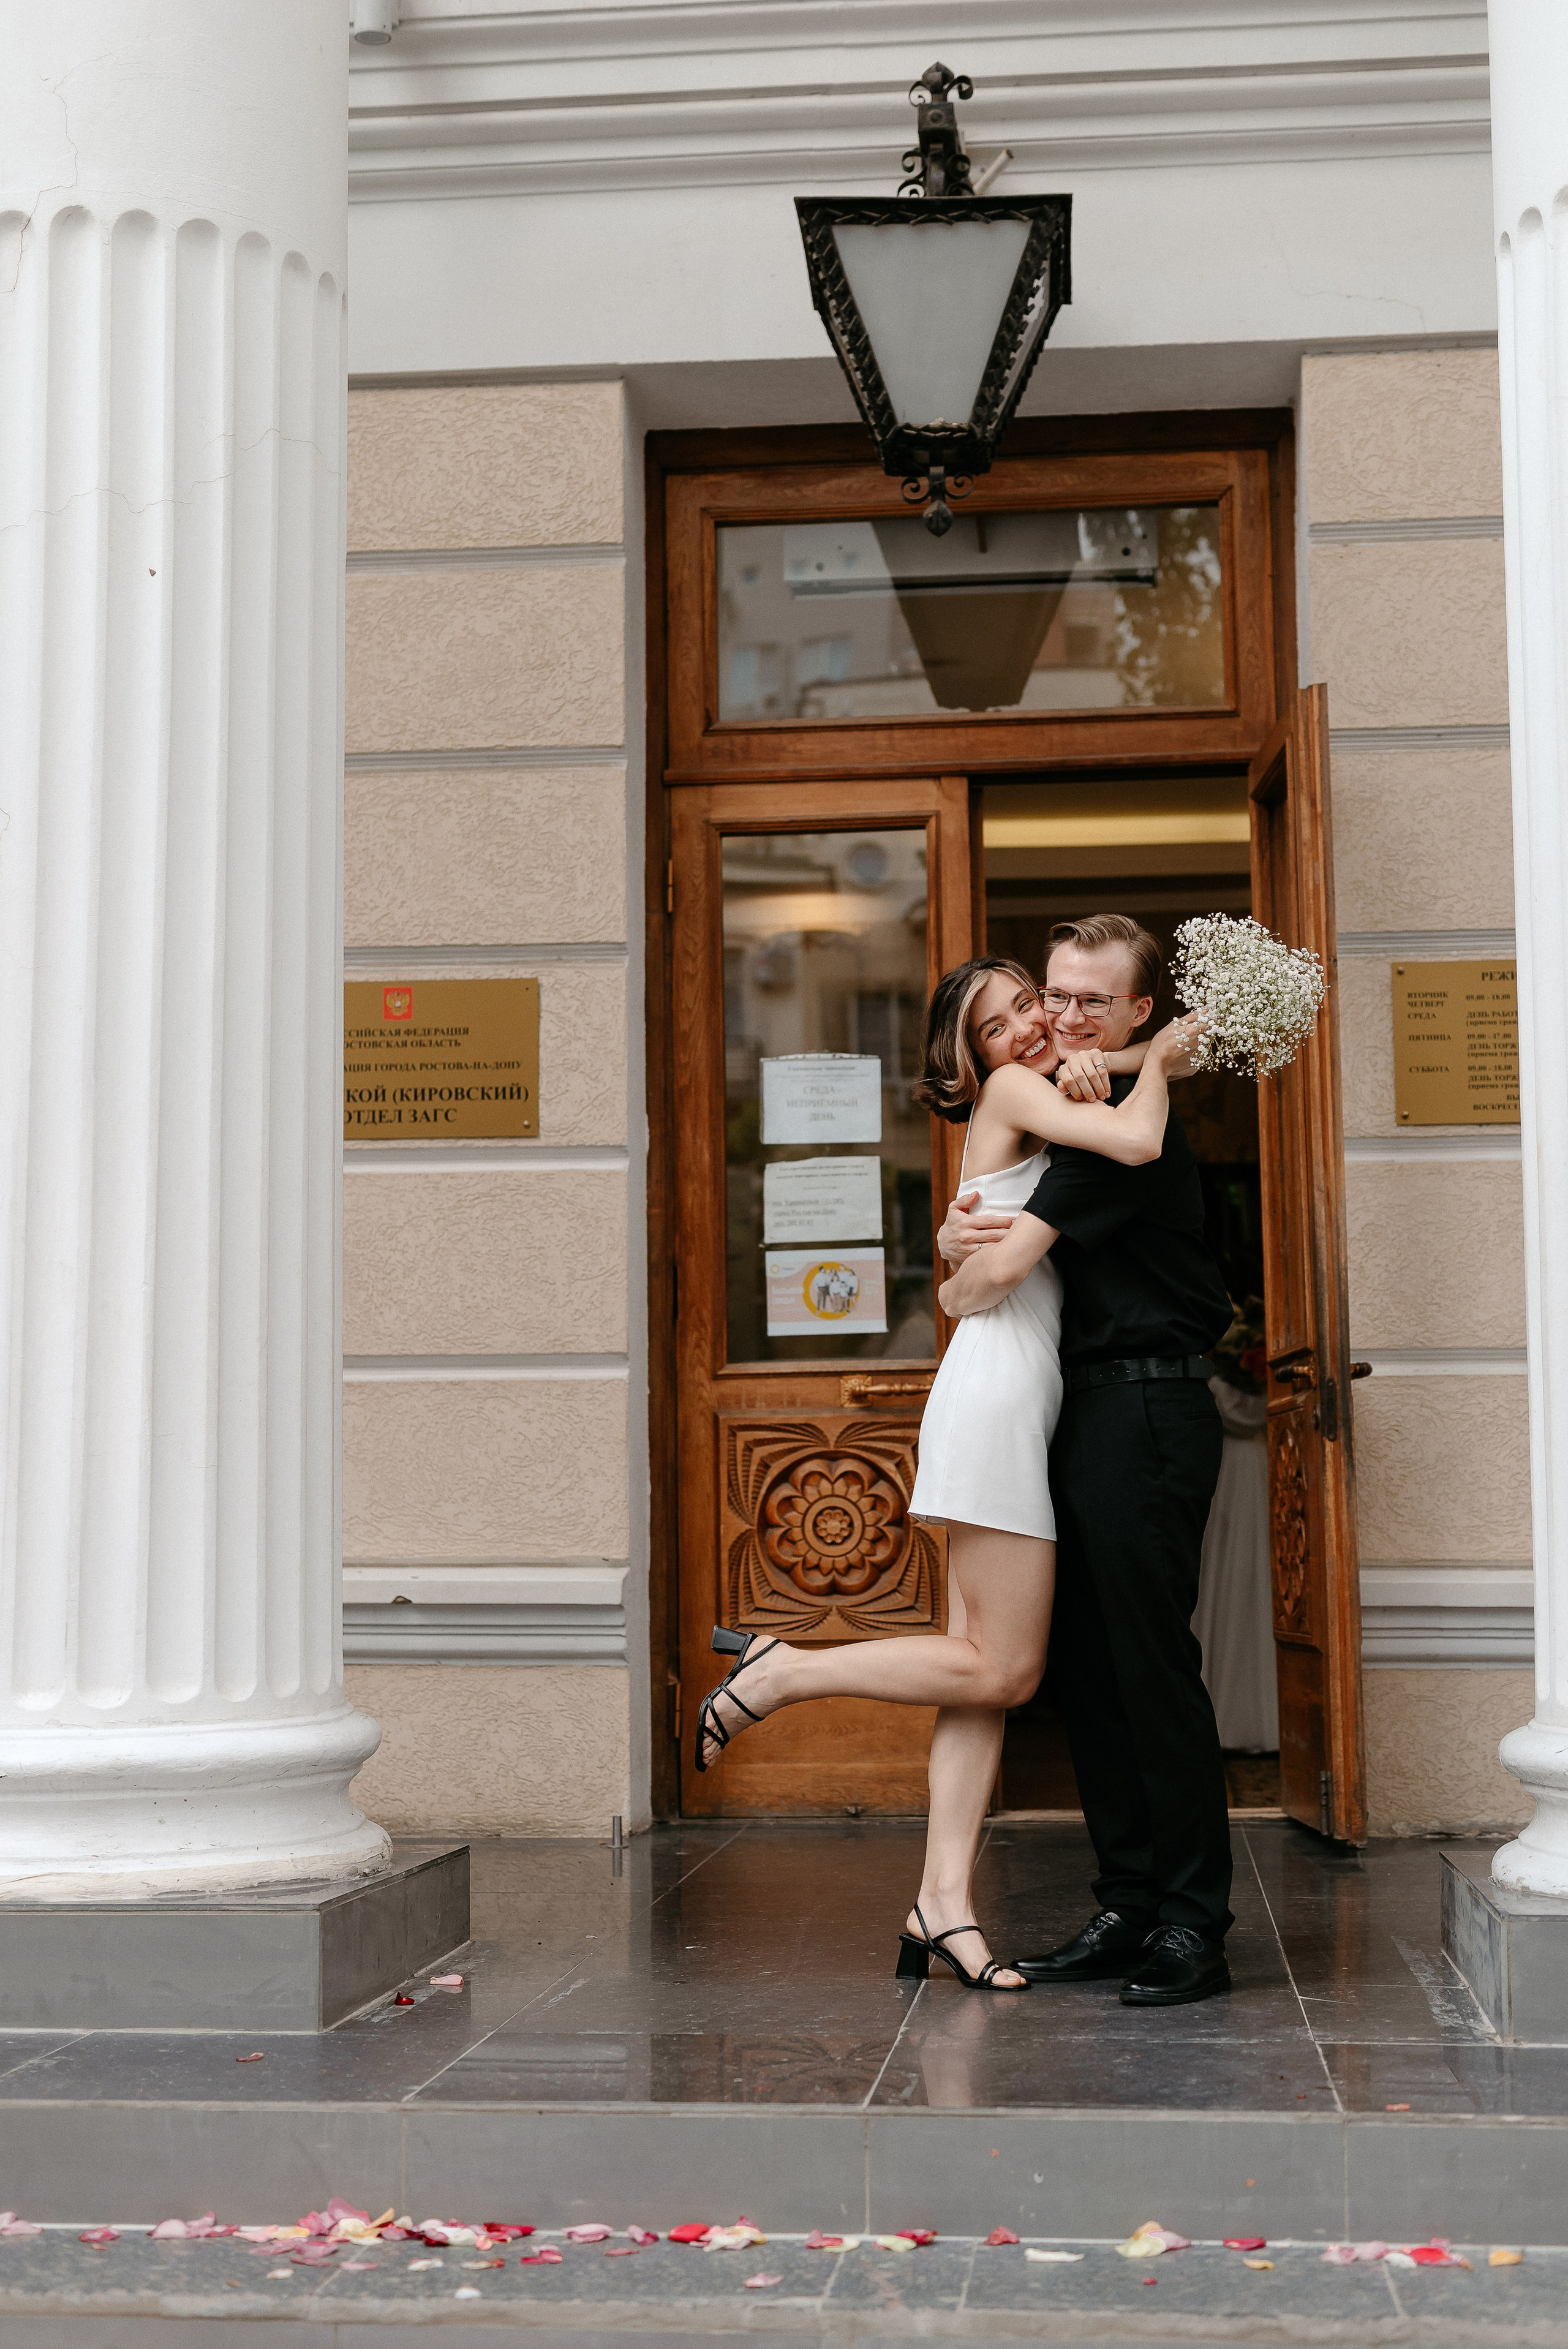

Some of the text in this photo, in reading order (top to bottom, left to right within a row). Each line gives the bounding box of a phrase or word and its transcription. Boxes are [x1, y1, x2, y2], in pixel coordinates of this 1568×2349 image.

[404, 1027, 469, 1038] ФЕДЕРАЦИЯ
[410, 1038, 461, 1049] ОБЛАСТЬ
[375, 1063, 417, 1073] ГОРОДА
[1468, 1074, 1492, 1083] ДЕНЬ
[393, 1083, 529, 1105] (КИРОВСКИЙ)
[409, 1107, 458, 1123] ЗАГС
